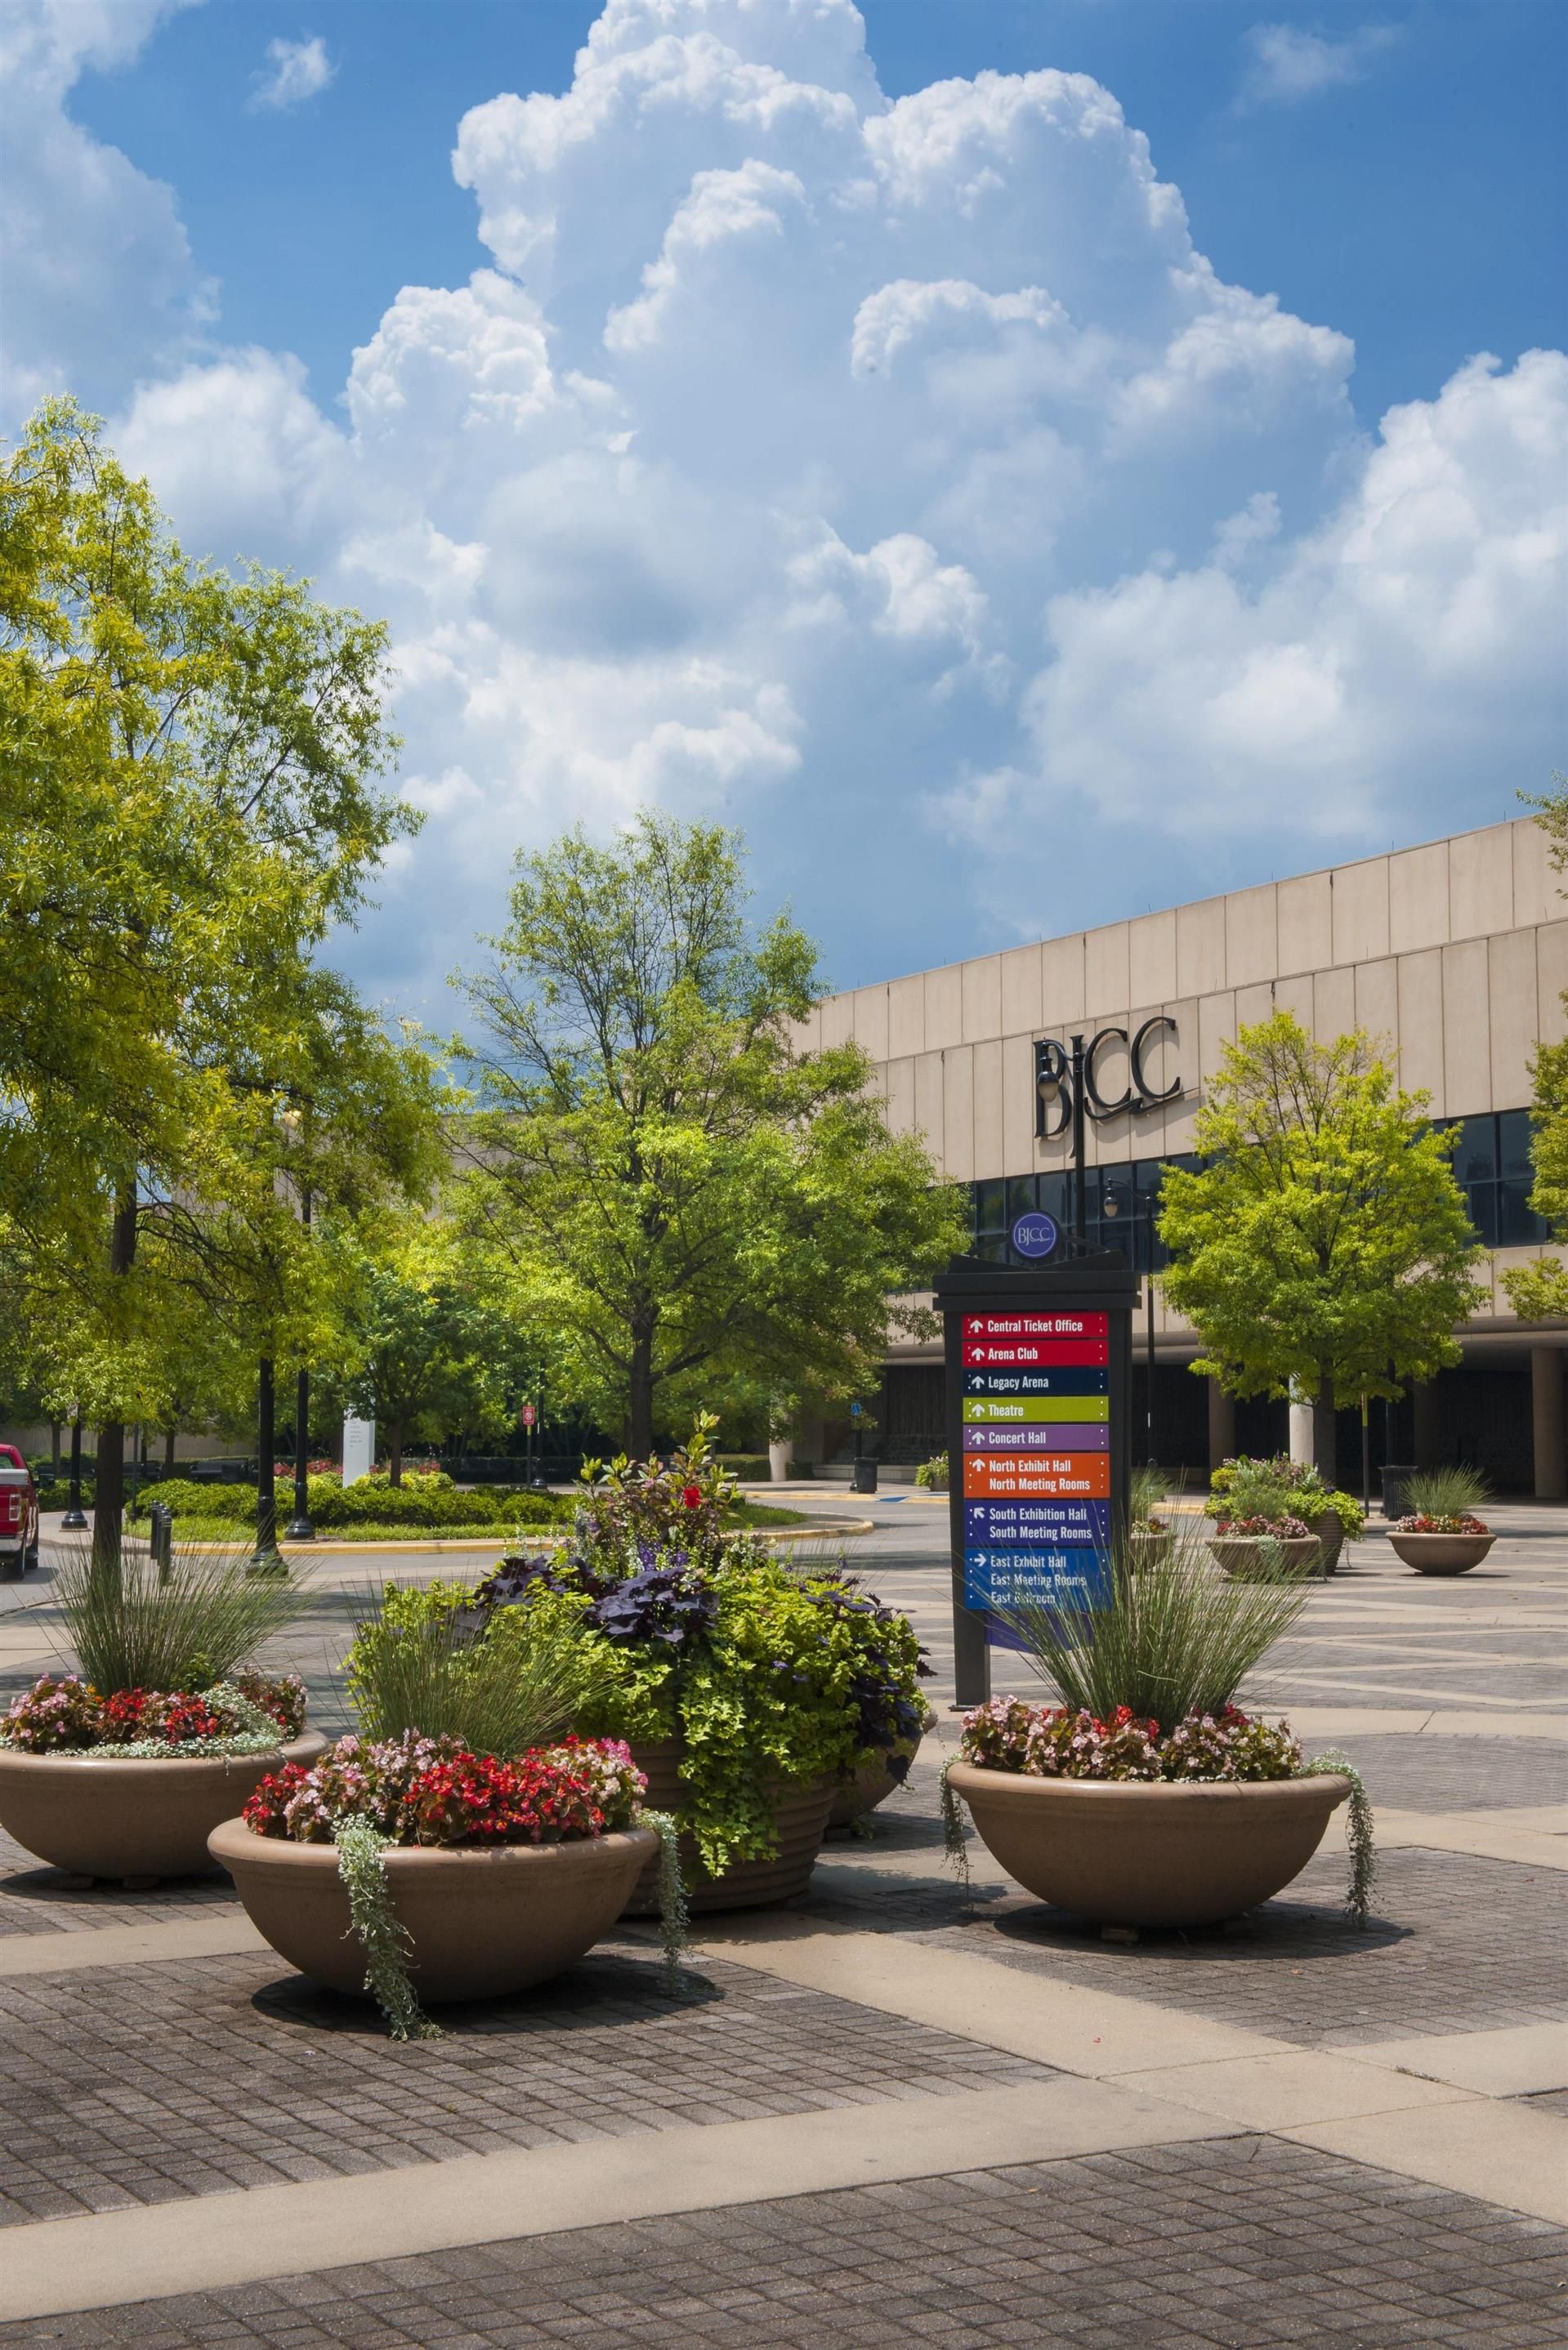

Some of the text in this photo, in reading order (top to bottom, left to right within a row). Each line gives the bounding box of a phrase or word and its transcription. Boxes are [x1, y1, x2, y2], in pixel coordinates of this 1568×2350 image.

[1018, 1227, 1052, 1246] BJCC
[987, 1319, 1083, 1333] Central Ticket Office
[988, 1347, 1039, 1360] Arena Club
[988, 1376, 1049, 1391] Legacy Arena
[988, 1404, 1024, 1417] Theatre
[989, 1432, 1047, 1445] Concert Hall
[989, 1459, 1071, 1472] North Exhibit Hall
[989, 1478, 1091, 1493] North Meeting Rooms
[989, 1508, 1087, 1521] South Exhibition Hall
[989, 1526, 1092, 1541] South Meeting Rooms
[990, 1555, 1066, 1568] East Exhibit Hall
[990, 1573, 1087, 1588] East Meeting Rooms
[990, 1591, 1012, 1605] East
